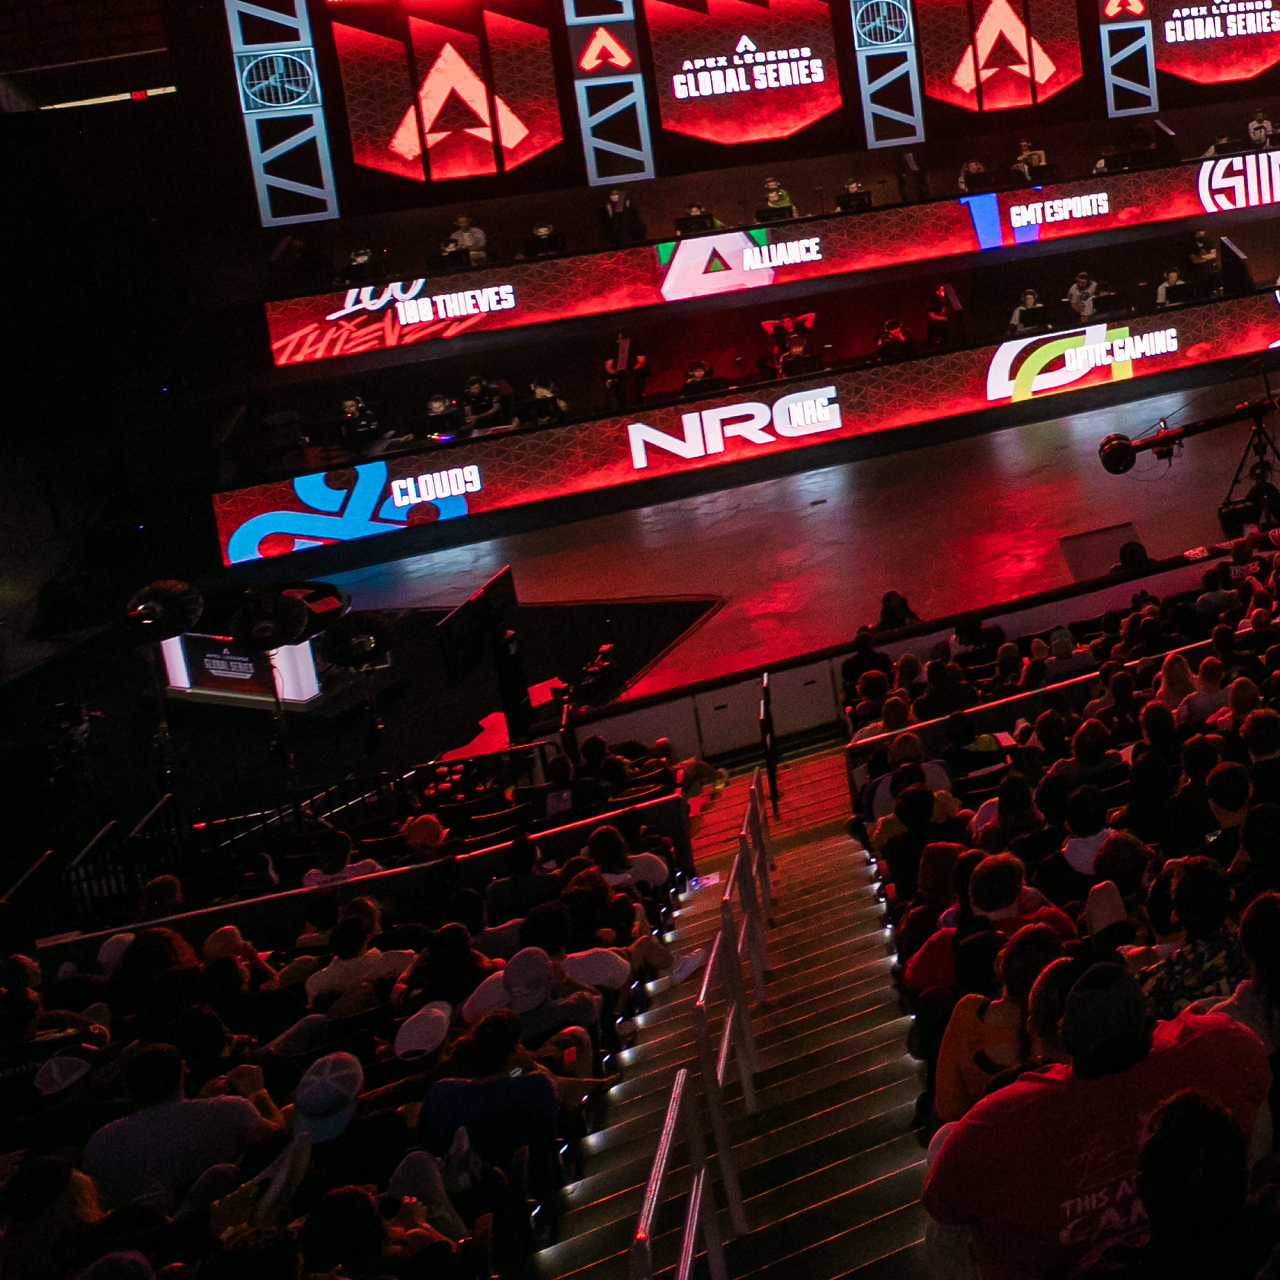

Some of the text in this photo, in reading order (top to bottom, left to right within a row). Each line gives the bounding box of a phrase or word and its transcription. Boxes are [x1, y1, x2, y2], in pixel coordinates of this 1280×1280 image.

[1172, 0, 1273, 19] APEX LEGENDS
[1165, 16, 1223, 43] GLOBAL
[682, 47, 811, 72] APEX LEGENDS
[673, 60, 824, 99] GLOBAL SERIES
[1010, 192, 1109, 228] GMT ESPORTS
[742, 237, 822, 271] ALLIANCE
[395, 284, 516, 325] 100 THIEVES
[1065, 327, 1178, 372] OPTIC GAMING
[628, 386, 842, 469] NRG
[788, 396, 830, 428] NRG
[391, 464, 482, 508] CLOUD9
[230, 661, 254, 673] SERIES
[1060, 1188, 1109, 1219] THIS
